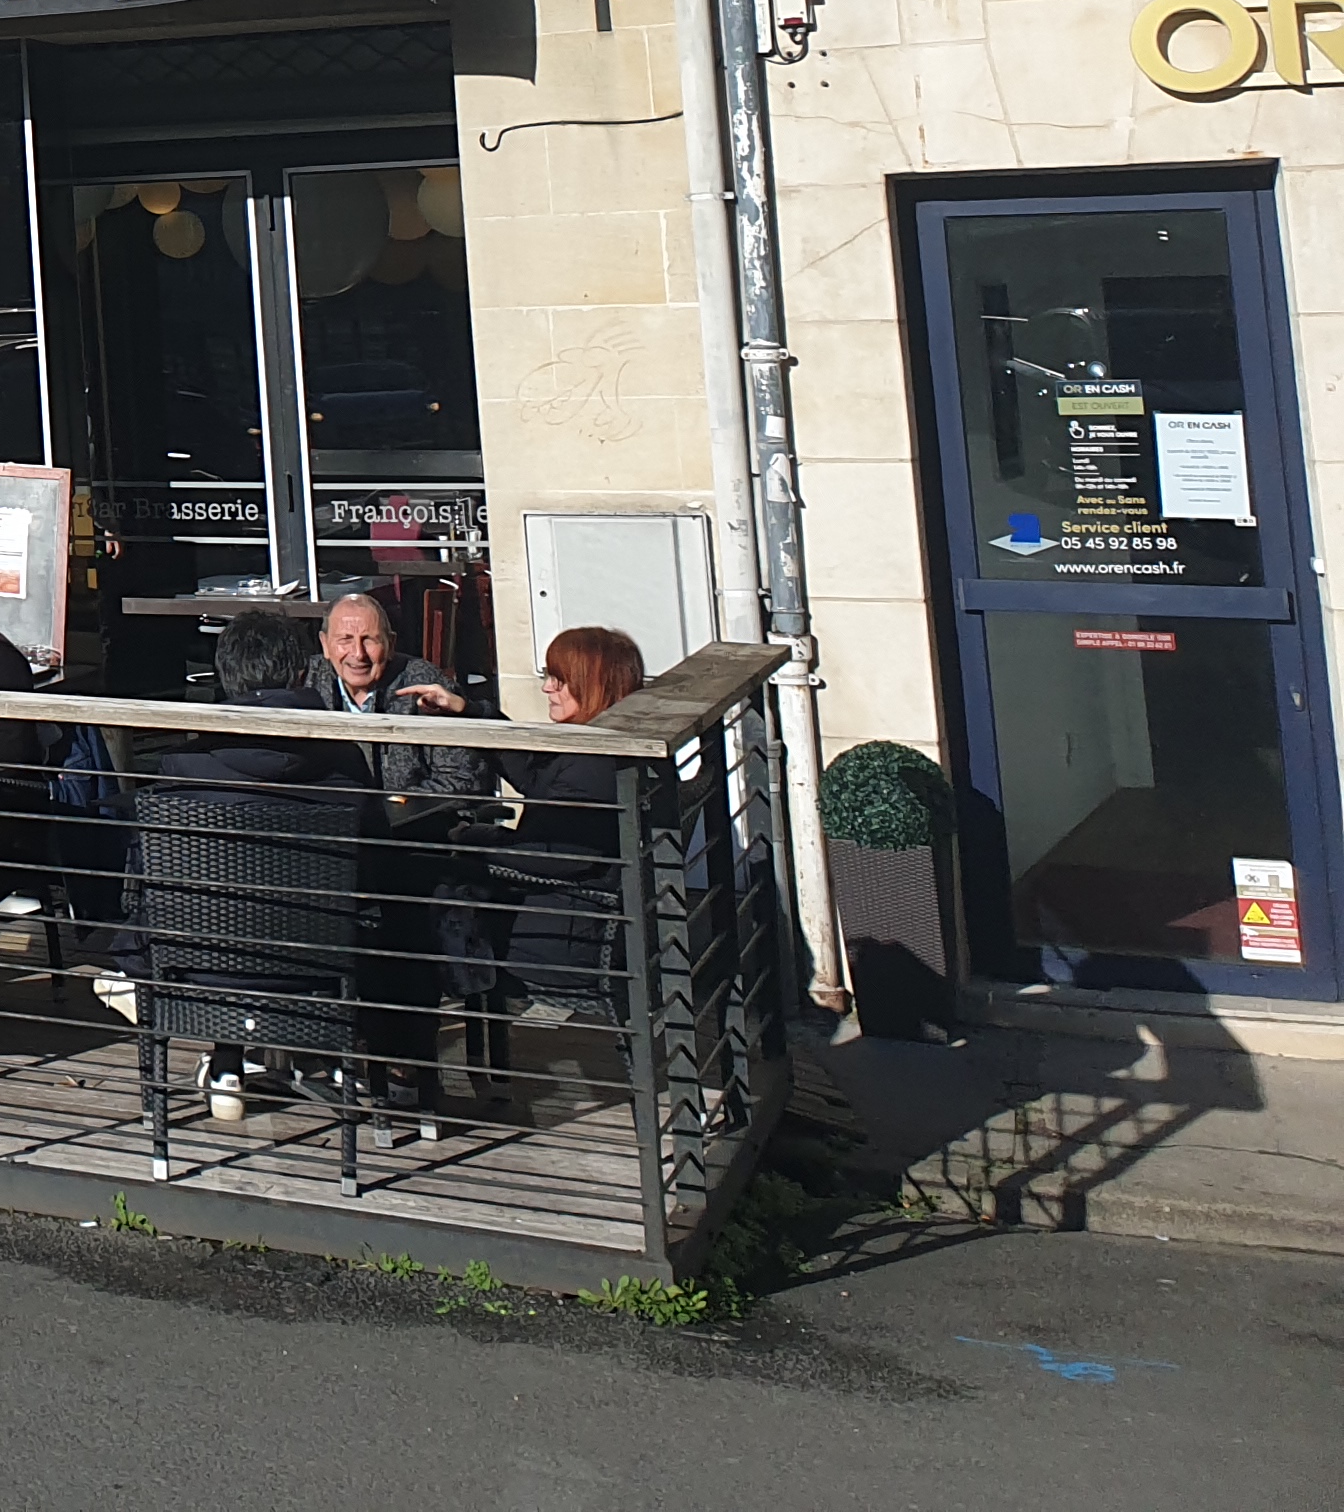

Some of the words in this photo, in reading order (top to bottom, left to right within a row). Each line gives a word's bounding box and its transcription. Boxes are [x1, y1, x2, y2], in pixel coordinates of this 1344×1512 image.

[1063, 384, 1083, 394] OR
[1084, 384, 1100, 394] EN
[1102, 383, 1135, 394] CASH
[1168, 421, 1185, 429] OR
[1187, 421, 1200, 430] EN
[1202, 422, 1231, 430] CASH
[1077, 495, 1103, 505] Avec
[1117, 495, 1146, 505] Sans
[134, 498, 259, 521] Brasserie
[330, 500, 452, 529] François
[1077, 506, 1148, 515] rendez-vous
[1062, 521, 1120, 534] Service
[1123, 521, 1168, 534] client
[1061, 537, 1081, 549] 05
[1085, 538, 1105, 549] 45
[1109, 538, 1129, 549] 92
[1132, 538, 1153, 549] 85
[1156, 538, 1178, 550] 98
[1054, 561, 1186, 575] www.orencash.fr
